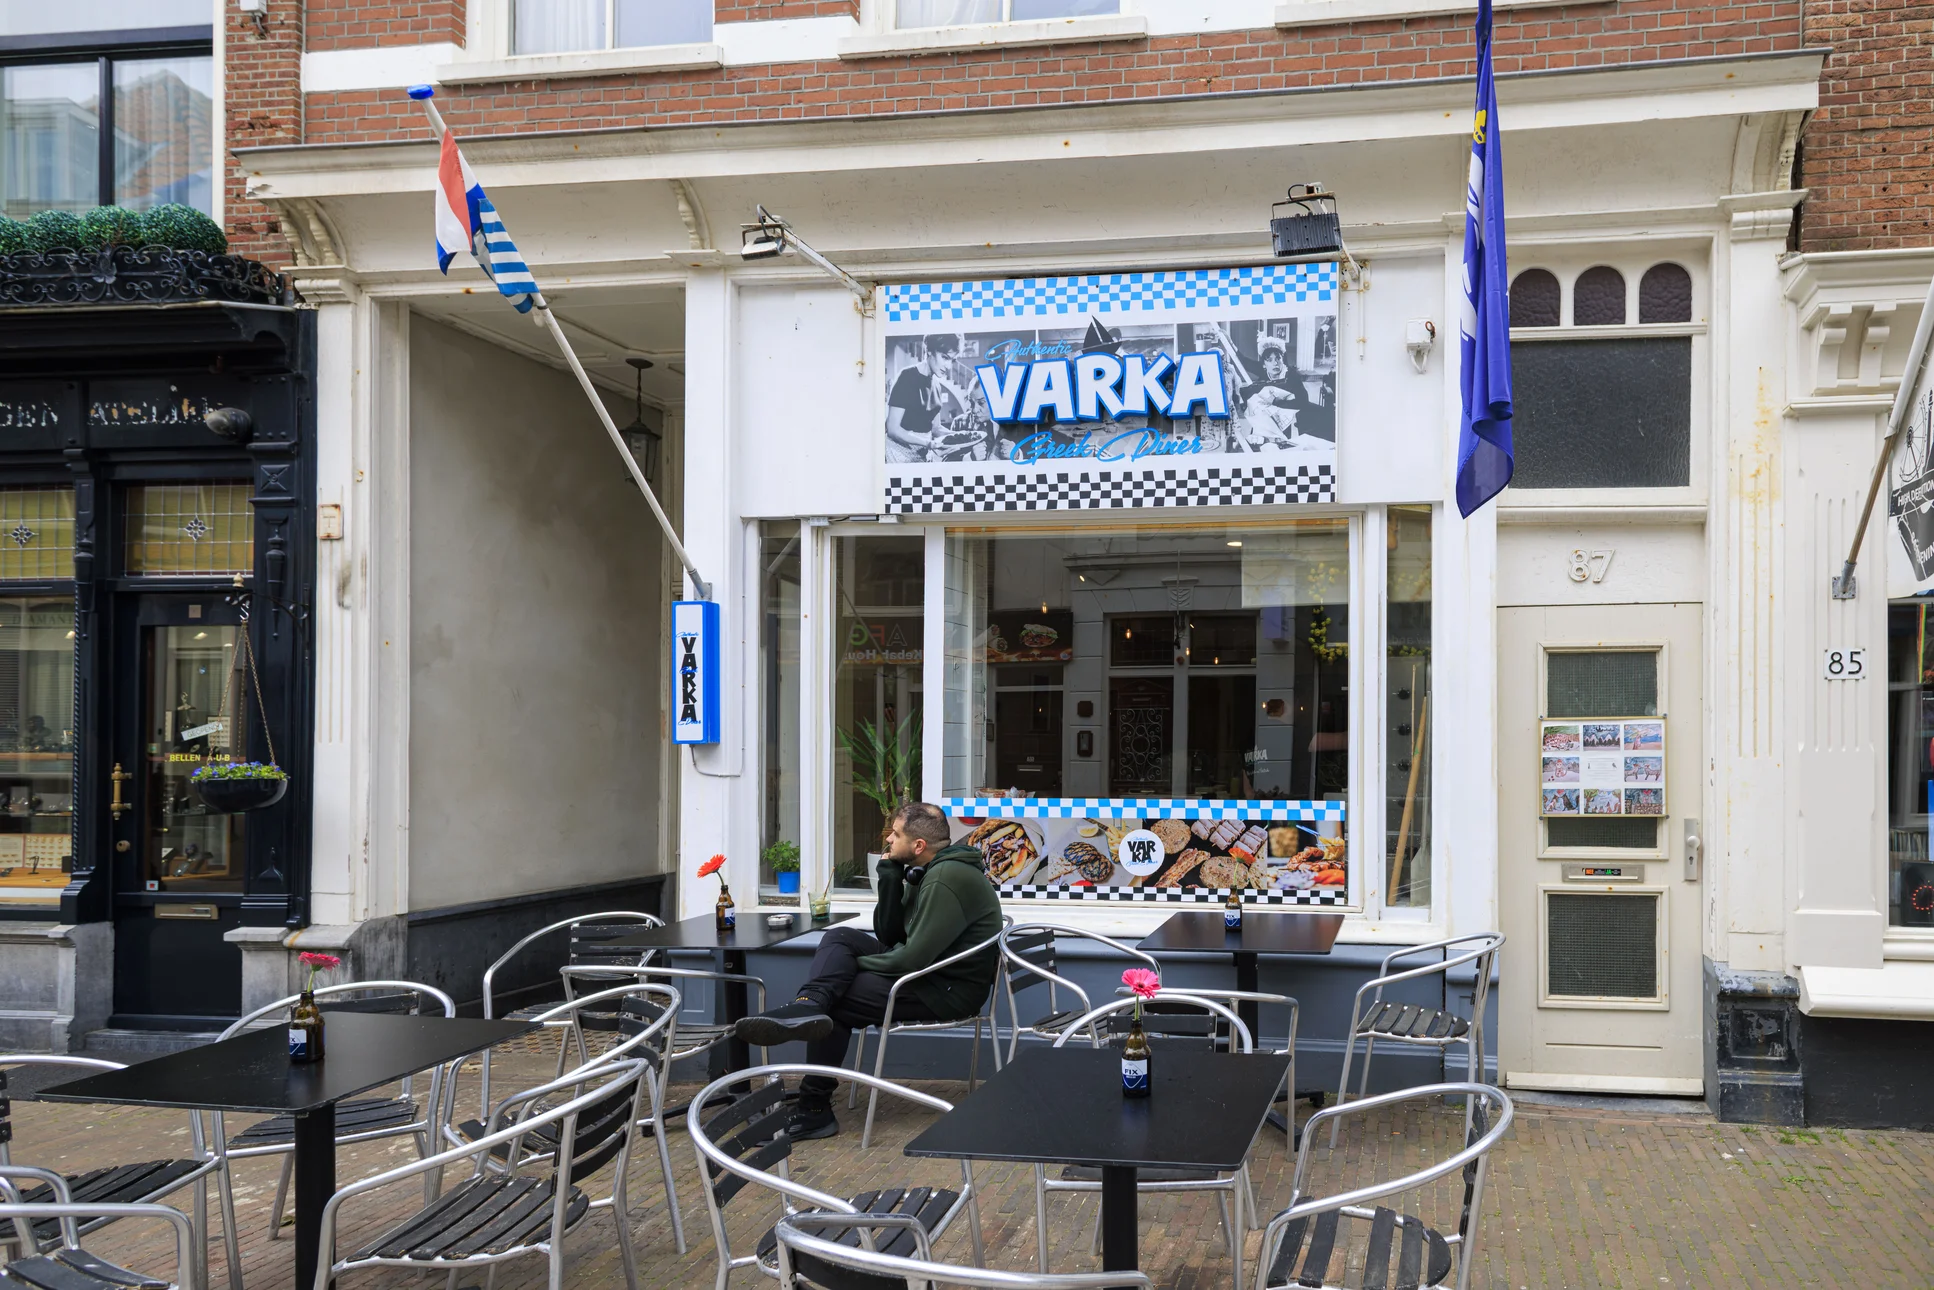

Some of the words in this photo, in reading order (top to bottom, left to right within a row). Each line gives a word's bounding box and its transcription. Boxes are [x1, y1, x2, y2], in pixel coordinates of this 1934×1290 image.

[984, 339, 1073, 361] Authentic
[974, 351, 1231, 423] VARKA
[1010, 431, 1093, 466] Greek
[1096, 427, 1203, 463] Diner
[1568, 549, 1616, 584] 87
[1829, 651, 1862, 675] 85
[681, 637, 697, 722] VARKA
[169, 754, 201, 762] BELLEN
[1244, 749, 1268, 762] VARKA
[1127, 840, 1156, 852] VAR
[1132, 850, 1152, 863] KA
